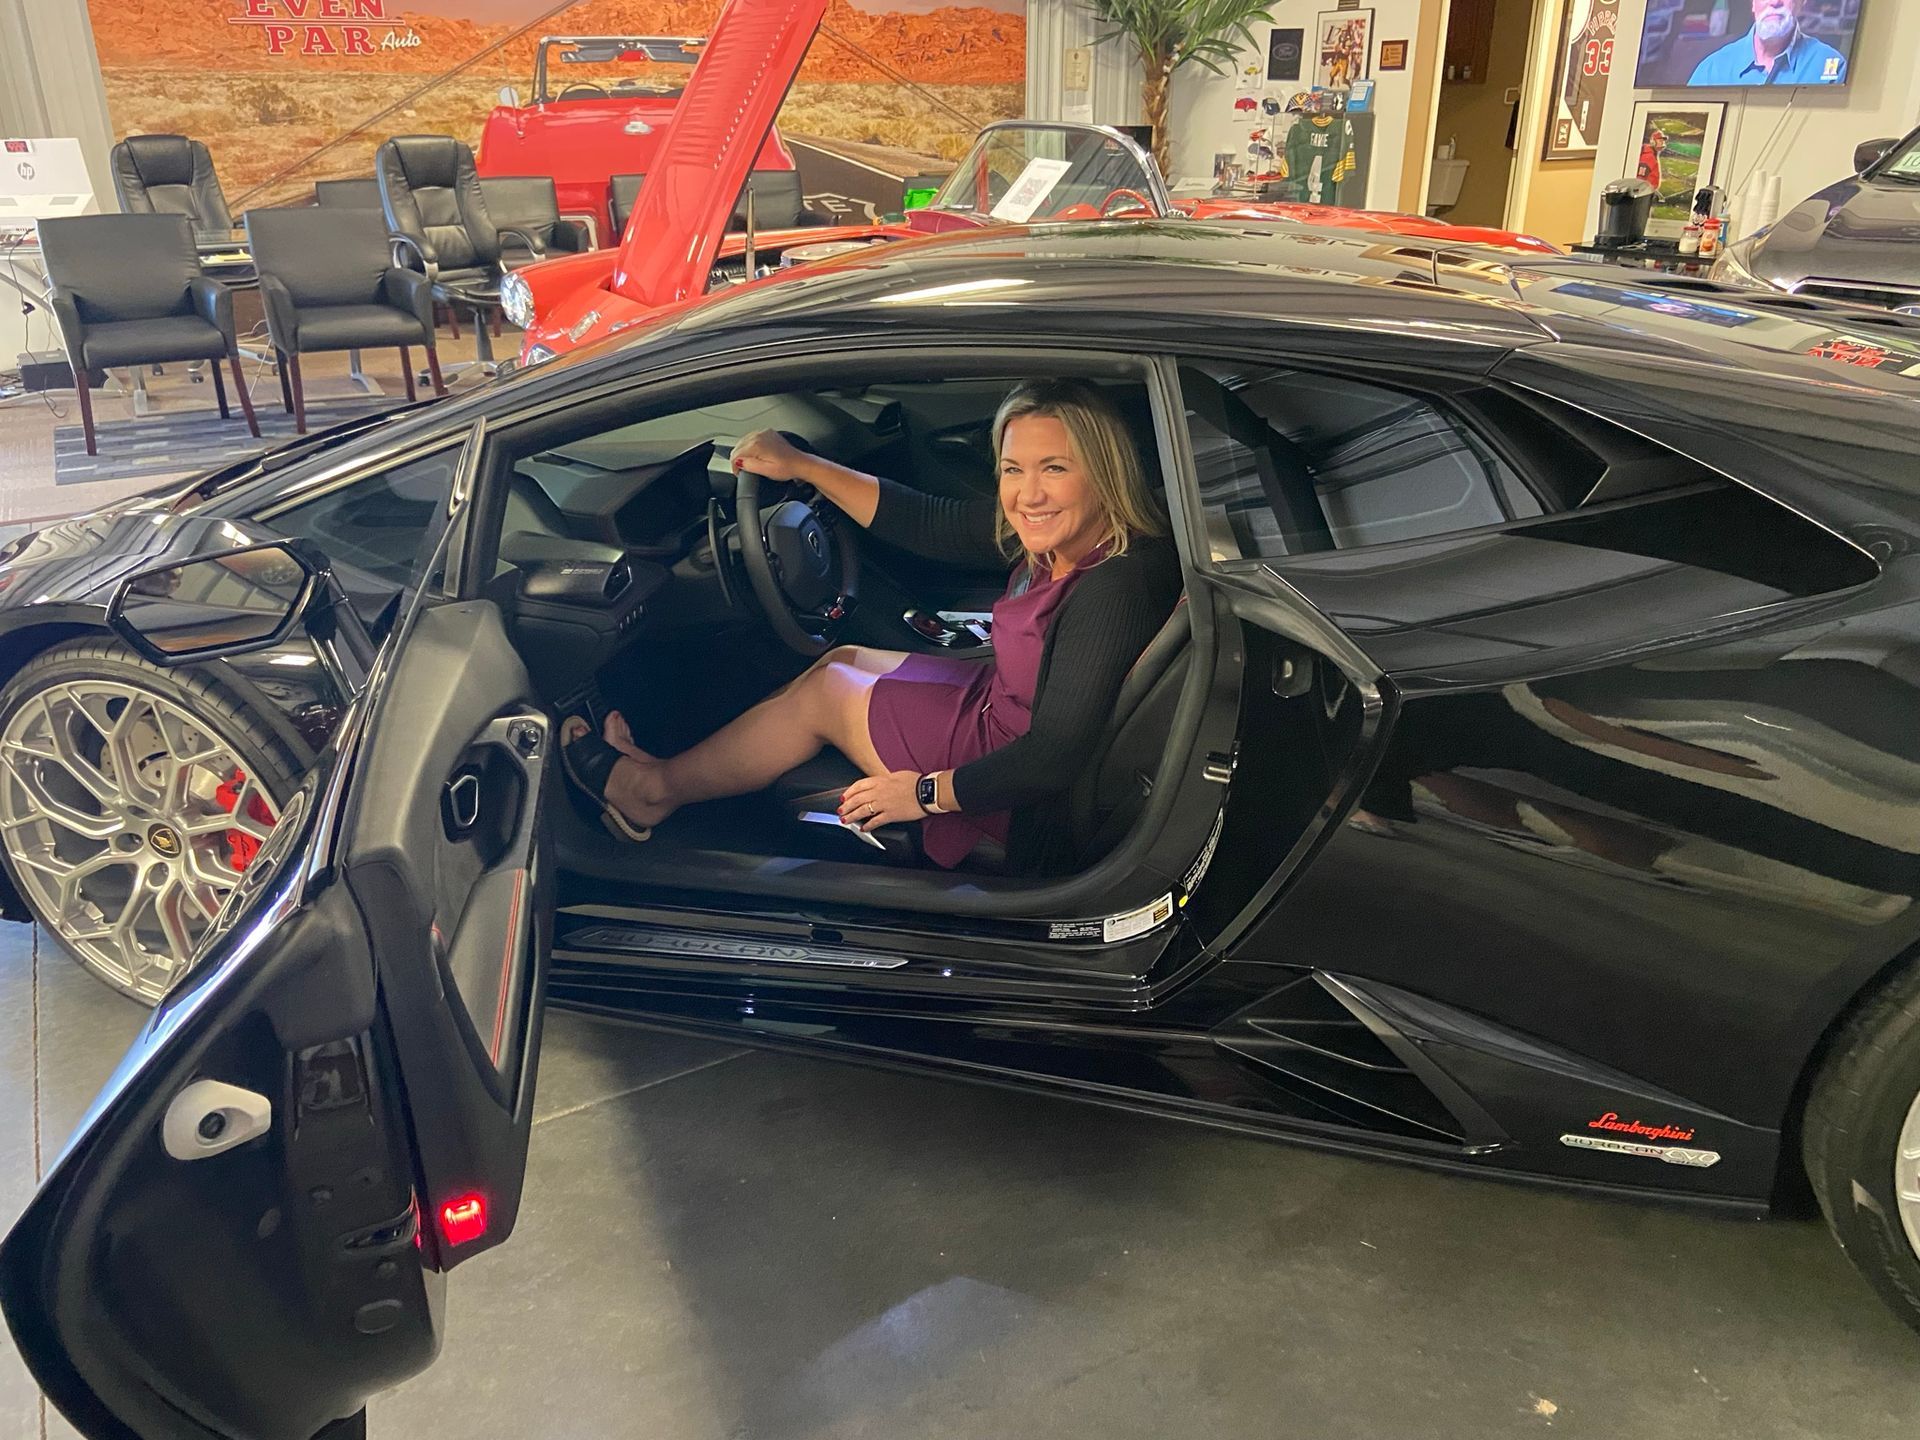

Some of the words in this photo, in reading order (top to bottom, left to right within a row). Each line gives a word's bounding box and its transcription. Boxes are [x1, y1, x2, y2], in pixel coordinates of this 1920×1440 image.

[246, 0, 386, 18] EVEN
[266, 25, 377, 55] PAR
[380, 29, 422, 51] Auto
[1583, 38, 1614, 76] 33
[17, 162, 35, 180] hp
[1307, 155, 1323, 203] 4
[1589, 1112, 1695, 1141] Lamborghini
